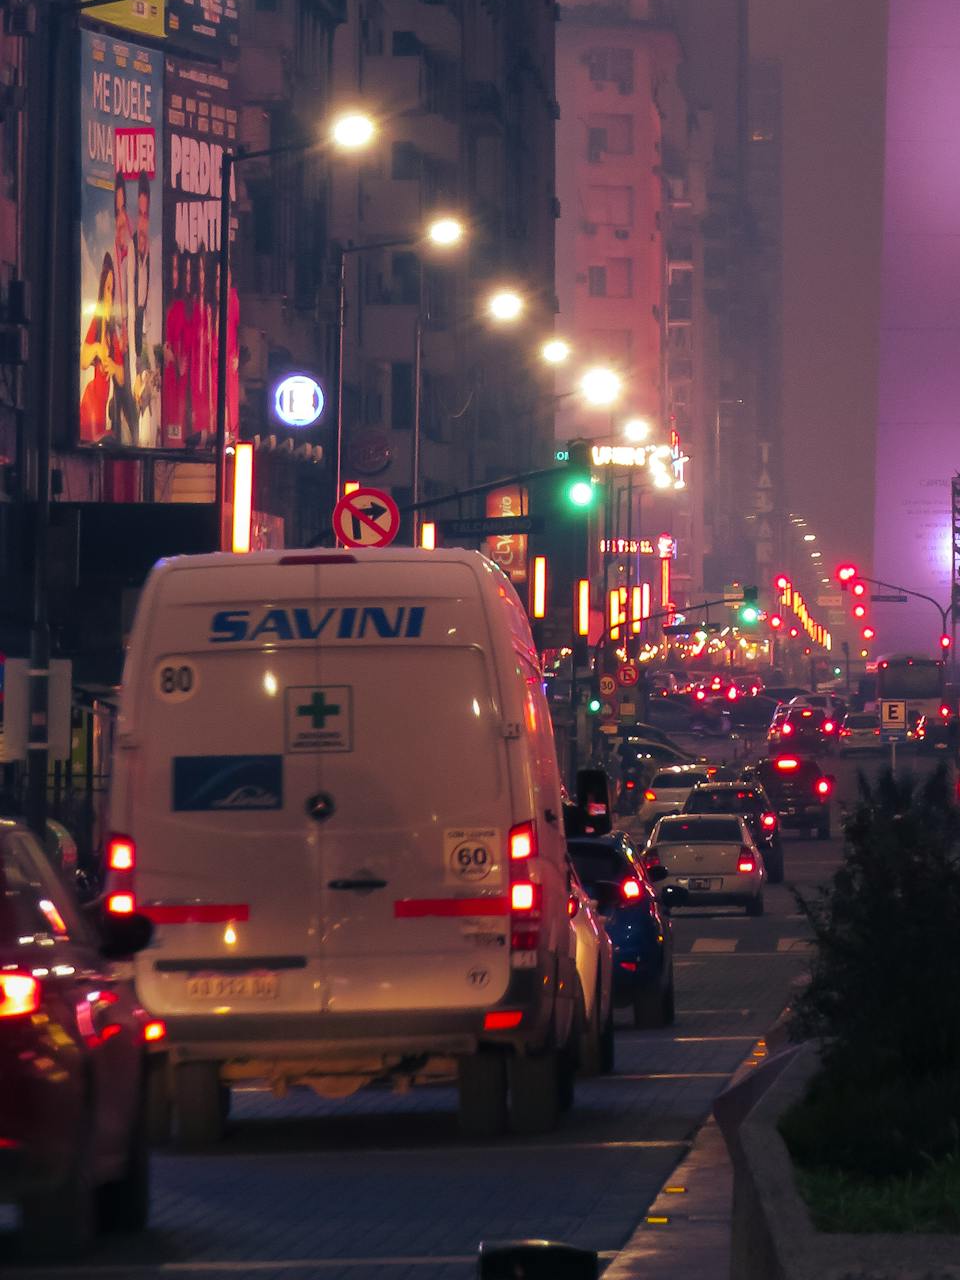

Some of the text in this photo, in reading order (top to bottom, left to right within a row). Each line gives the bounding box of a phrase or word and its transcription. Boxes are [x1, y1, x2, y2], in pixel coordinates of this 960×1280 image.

[93, 70, 111, 113] ME
[113, 76, 152, 124] DUELE
[88, 120, 155, 174] UNA MUJER
[208, 607, 426, 643] SAVINI
[160, 665, 193, 693] 80
[600, 681, 613, 691] 30
[888, 704, 899, 720] E
[458, 847, 488, 867] 60
